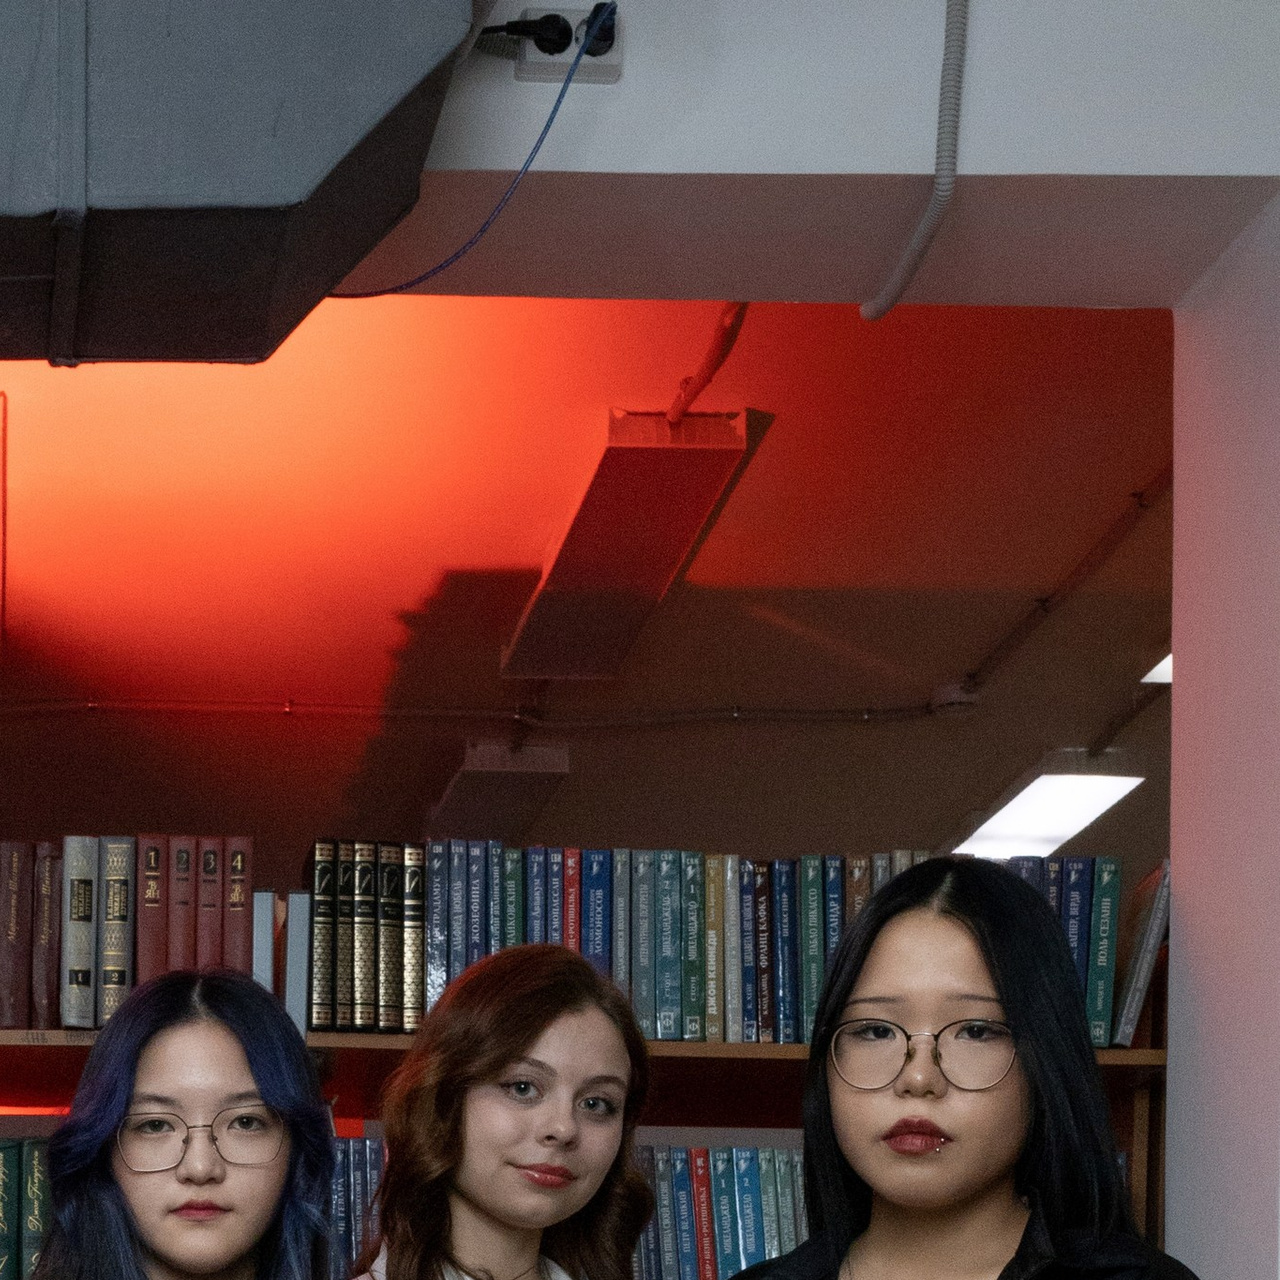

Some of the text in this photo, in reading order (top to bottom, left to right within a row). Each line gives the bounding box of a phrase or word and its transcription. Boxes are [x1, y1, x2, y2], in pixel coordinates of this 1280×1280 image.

[148, 851, 156, 868] 1
[178, 853, 187, 868] 2
[205, 854, 215, 870] 3
[231, 853, 242, 870] 4
[551, 878, 560, 929] МОПАССАН
[664, 880, 670, 890] 2
[689, 884, 694, 894] 1
[472, 879, 482, 944] ЖОЗЕФИНА
[595, 889, 604, 955] ЛОМОНОСОВ
[782, 892, 790, 937] ШЕКСПИР
[809, 887, 819, 956] ПАБЛО ПИКАССО
[829, 904, 840, 952] ЕКСАНДР
[758, 896, 769, 968] ФРАНЦ КАФКА
[1096, 897, 1112, 967] ПОЛЬ СЕЗАНН
[707, 930, 718, 979] КЕННЕДИ
[708, 981, 718, 1015] ДЖОН
[337, 1178, 346, 1218] ГЕВАРА
[720, 1179, 726, 1188] 1
[744, 1177, 750, 1186] 2
